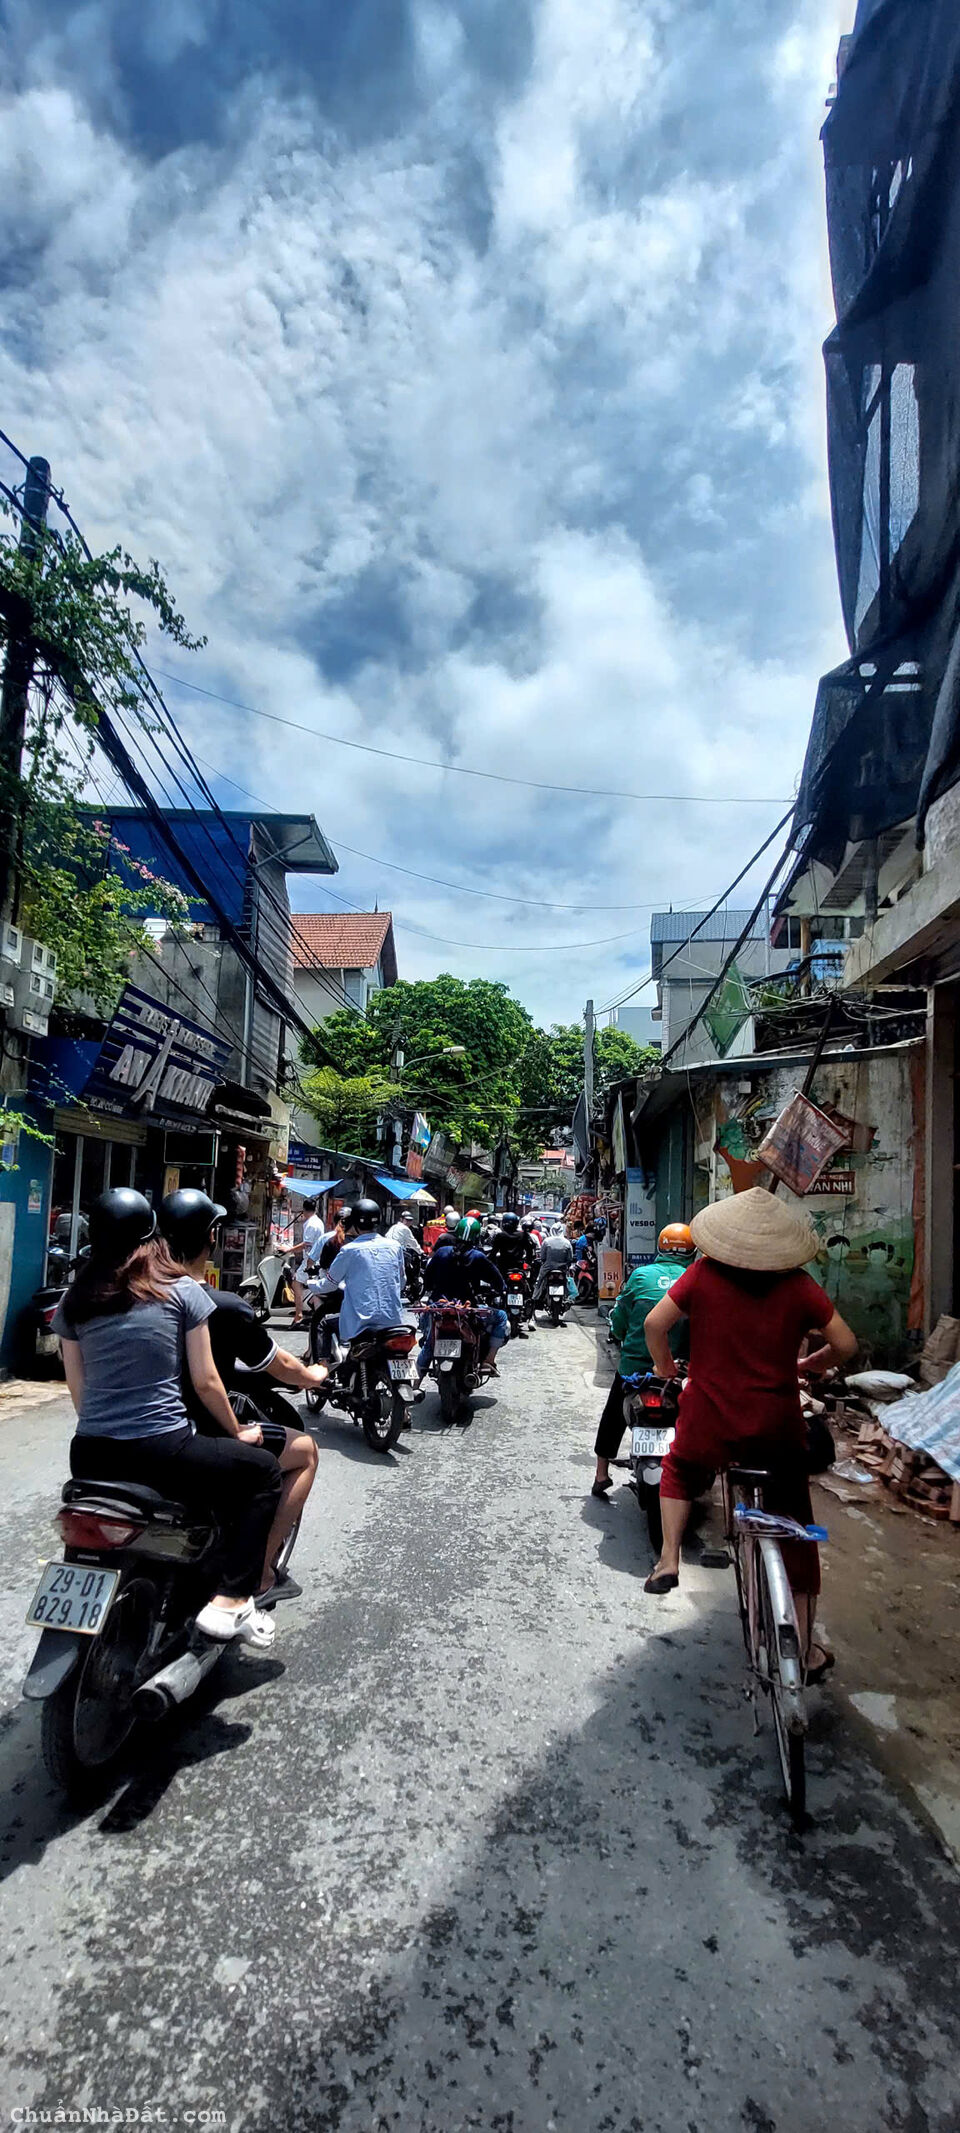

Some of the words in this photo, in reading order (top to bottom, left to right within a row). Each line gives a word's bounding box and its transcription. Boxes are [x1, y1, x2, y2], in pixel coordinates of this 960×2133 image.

[109, 1044, 152, 1089] AN
[810, 1181, 830, 1192] AN
[833, 1181, 852, 1192] NHI
[603, 1272, 620, 1281] 15K
[638, 1429, 668, 1441] 29-K7
[49, 1568, 106, 1599] 29-D1
[33, 1595, 102, 1629] 829.18
